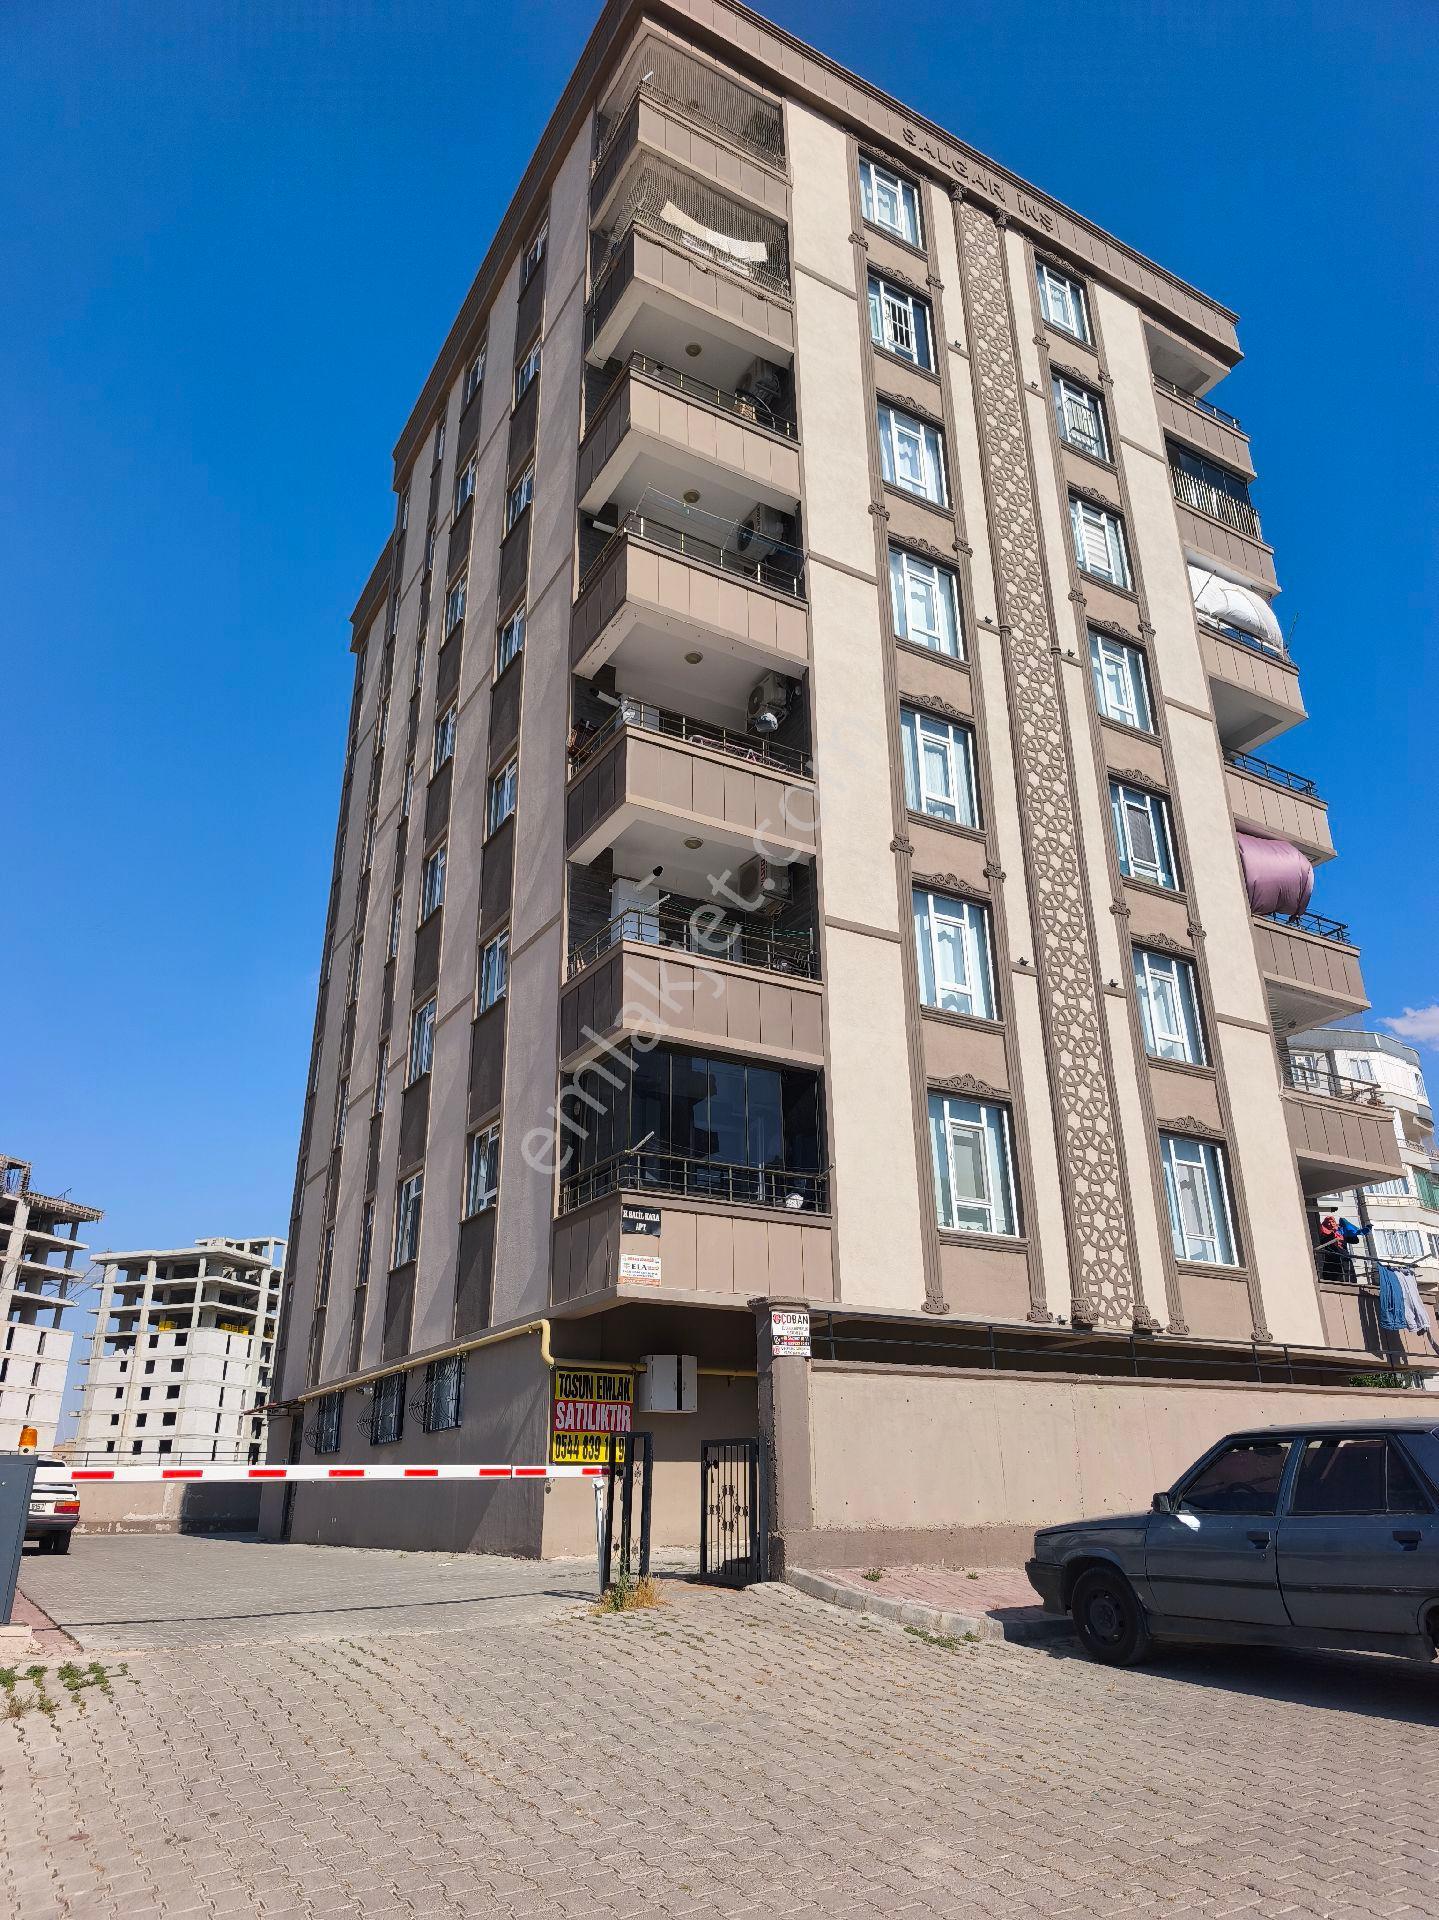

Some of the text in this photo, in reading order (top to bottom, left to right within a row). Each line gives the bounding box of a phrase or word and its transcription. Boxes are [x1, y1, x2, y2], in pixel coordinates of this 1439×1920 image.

[558, 1373, 631, 1402] TOSUN EMLAK
[555, 1401, 631, 1433] SATILIKTIR
[555, 1433, 580, 1460] 0544
[582, 1434, 601, 1461] 839
